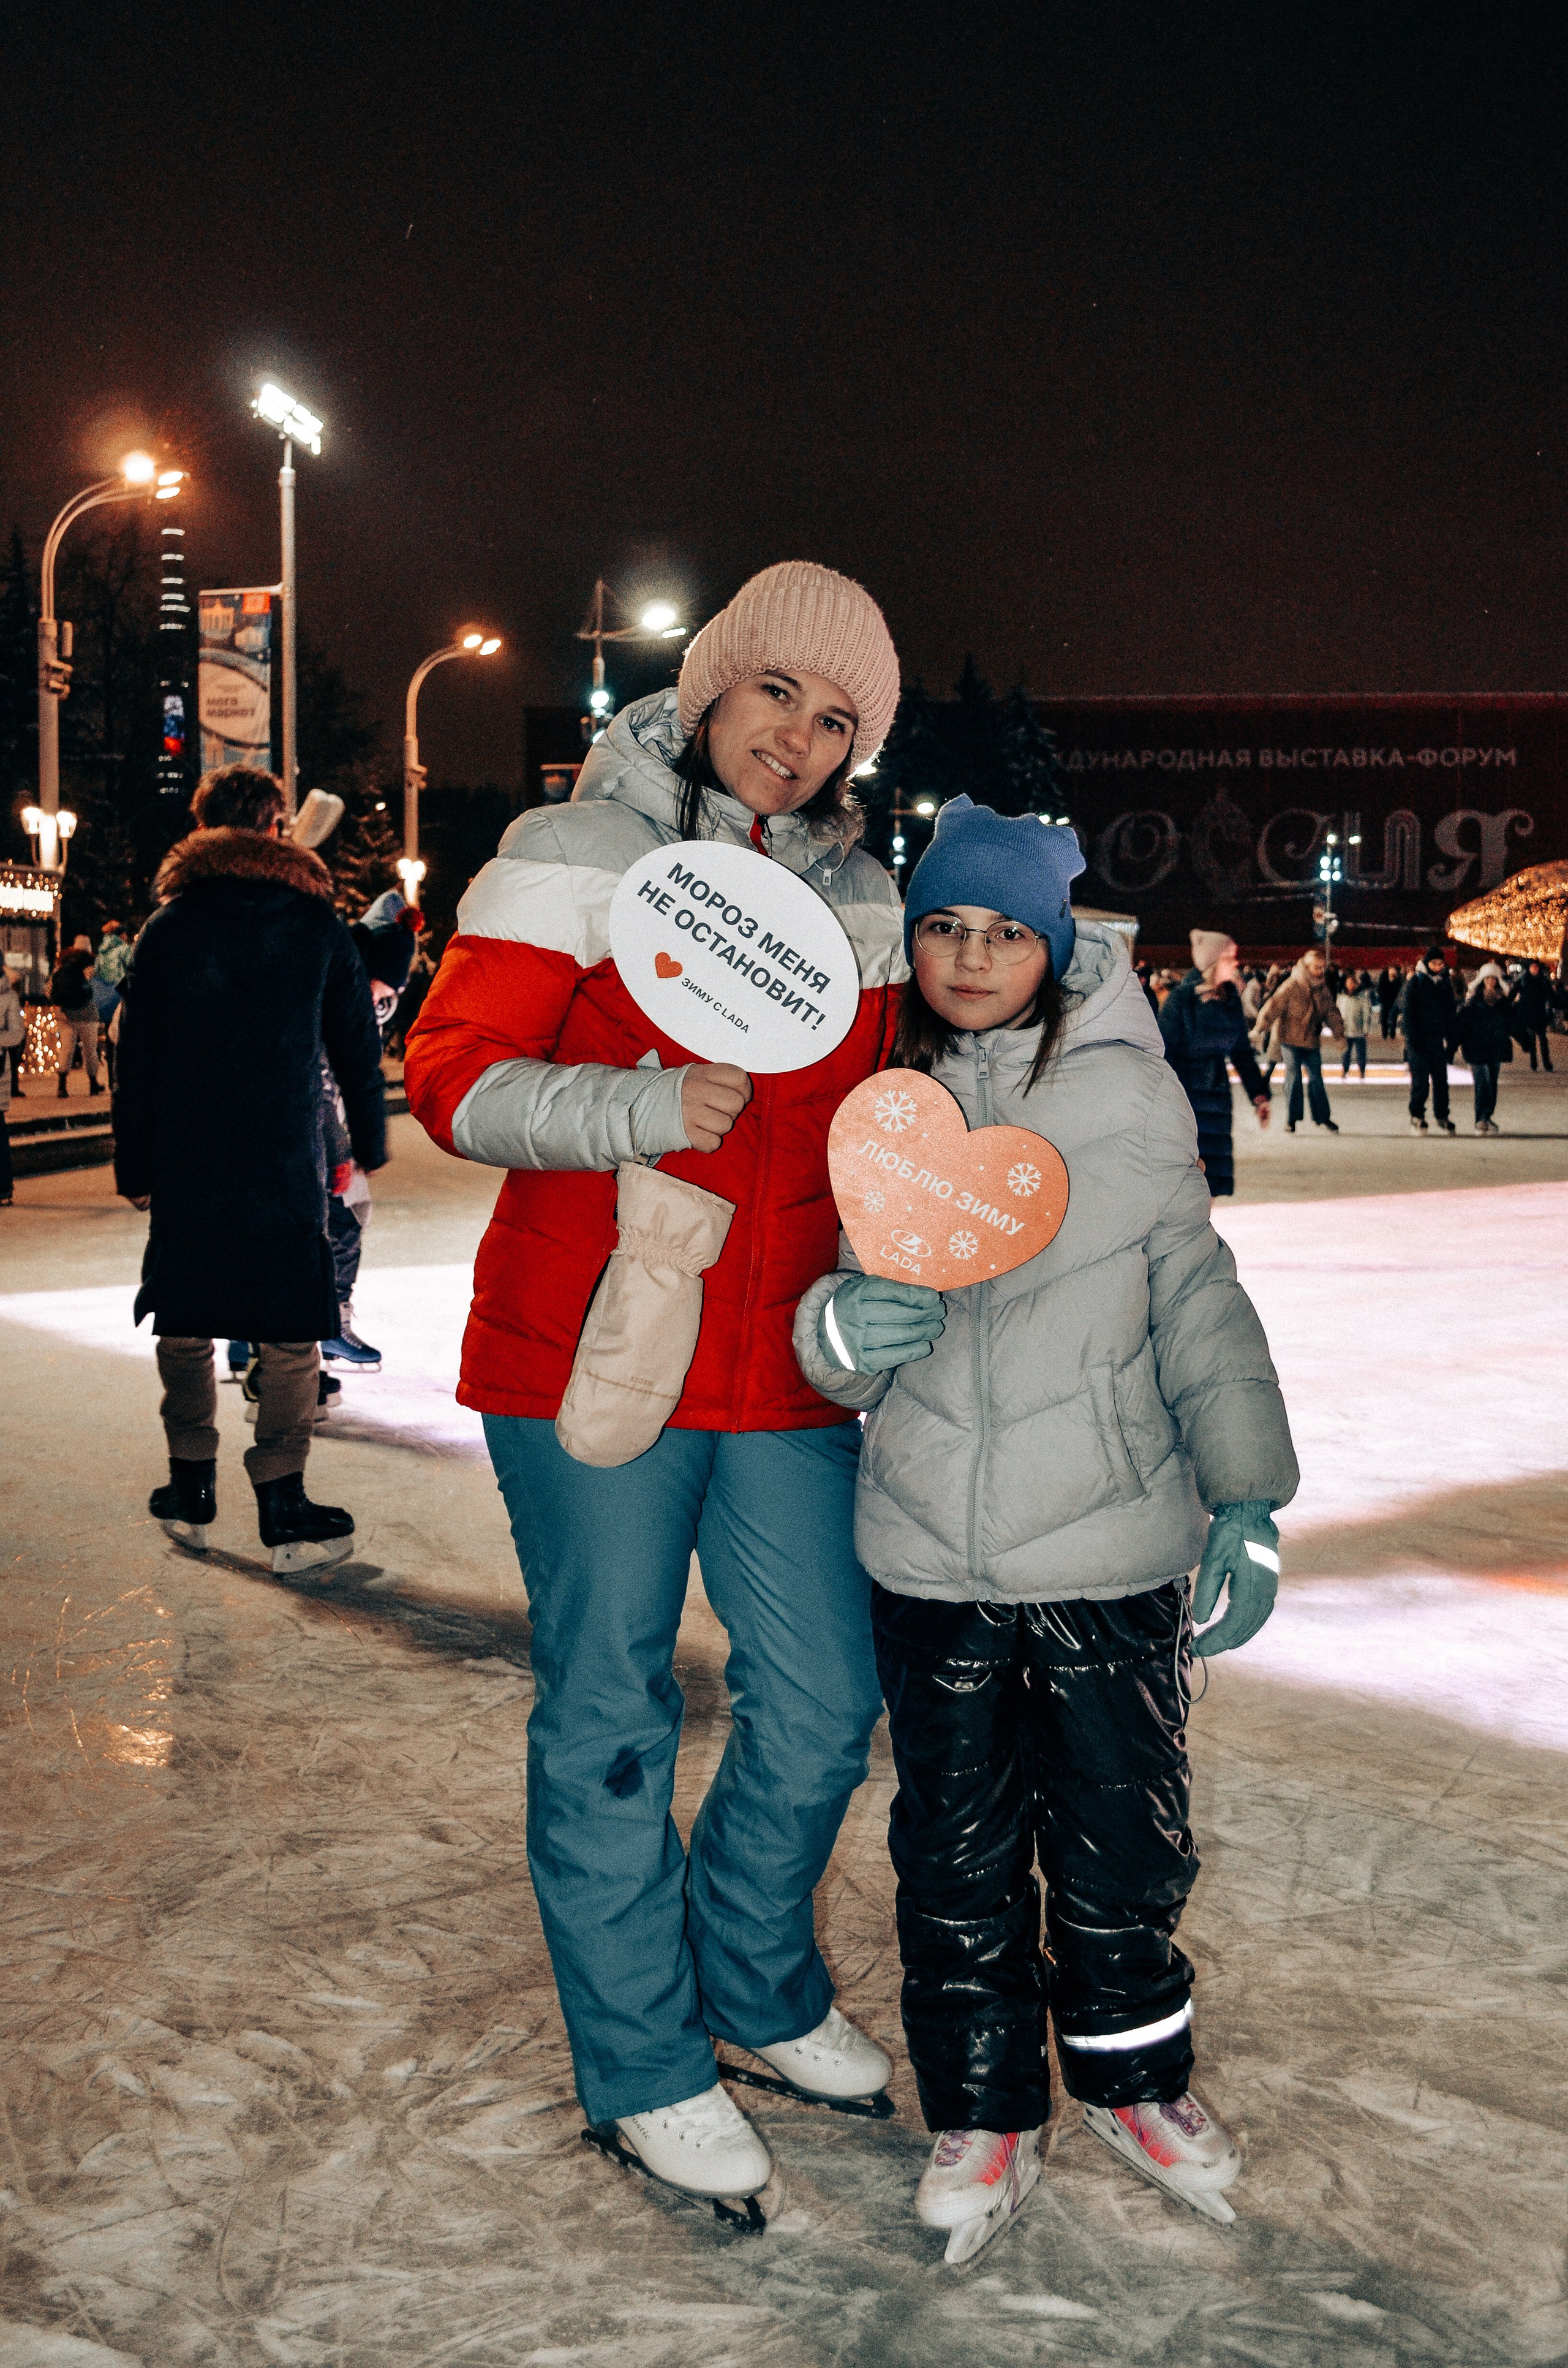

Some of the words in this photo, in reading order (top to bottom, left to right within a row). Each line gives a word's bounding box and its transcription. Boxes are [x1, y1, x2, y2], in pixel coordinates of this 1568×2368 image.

[1054, 748, 1251, 770] ДУНАРОДНАЯ
[1259, 746, 1517, 770] ВЫСТАВКА-ФОРУМ
[1079, 796, 1535, 898] ОССИЯ
[636, 880, 676, 916] НЕ
[674, 909, 826, 1031] ОСТАНОВИТ!
[666, 862, 759, 939] МОРОЗ
[757, 931, 832, 994] МЕНЯ
[681, 977, 714, 1004] ЗИМУ
[713, 1002, 722, 1012] С
[721, 1008, 750, 1034] LADA
[858, 1140, 953, 1199] ЛЮБЛЮ
[956, 1192, 1025, 1236] ЗИМУ
[879, 1246, 922, 1276] LADA
